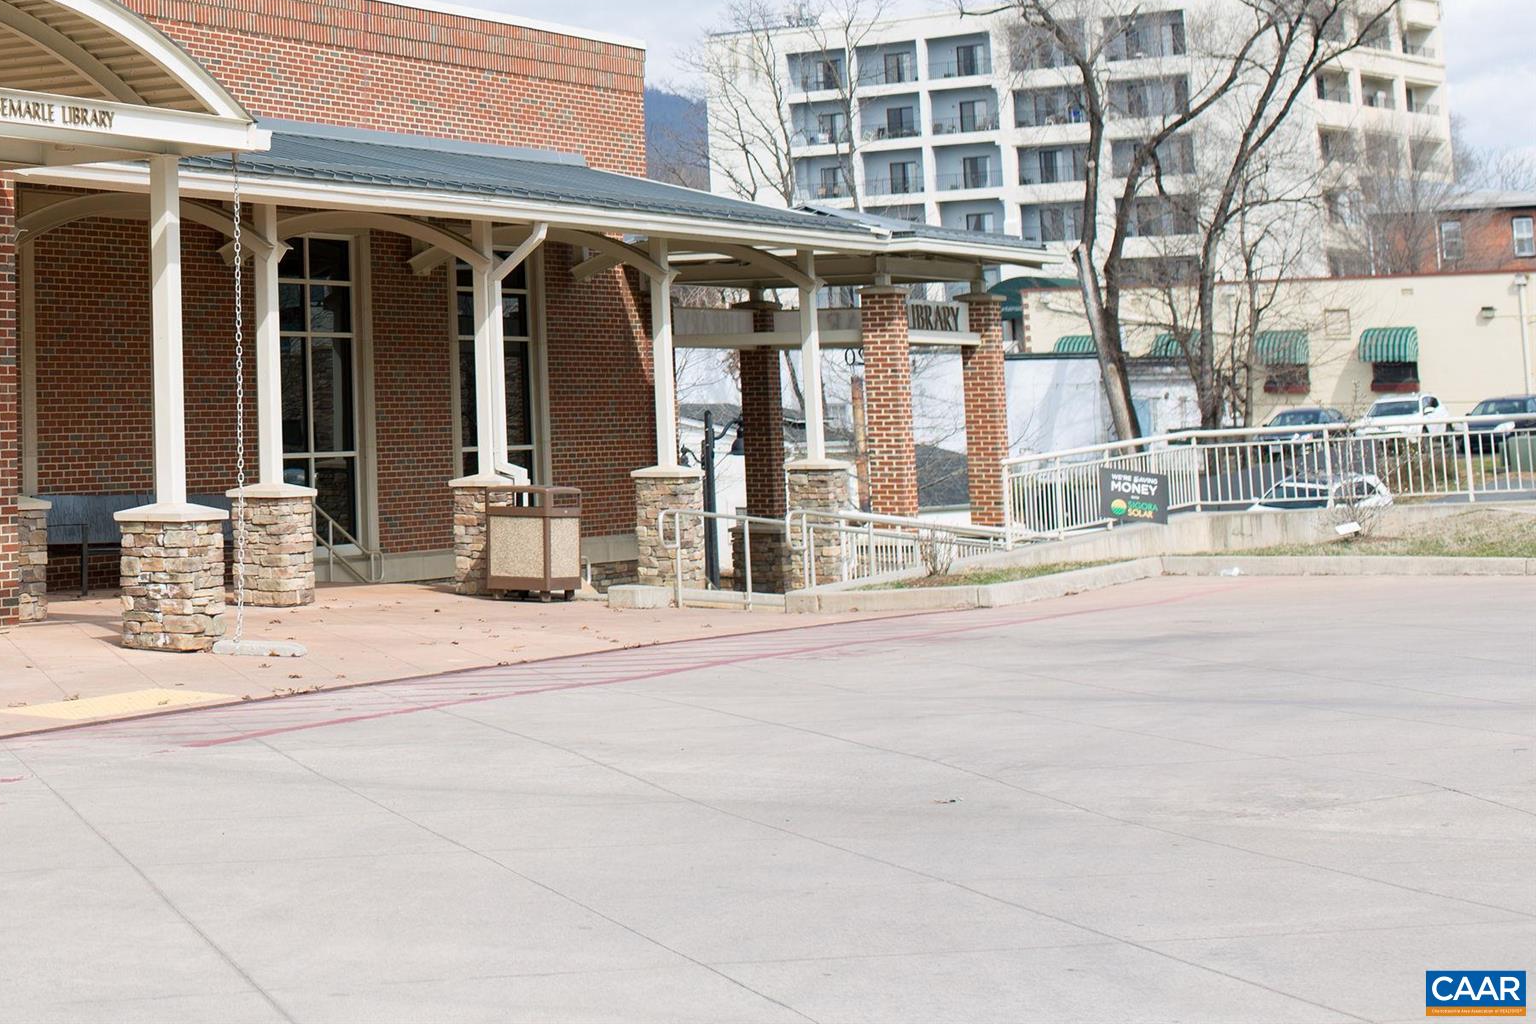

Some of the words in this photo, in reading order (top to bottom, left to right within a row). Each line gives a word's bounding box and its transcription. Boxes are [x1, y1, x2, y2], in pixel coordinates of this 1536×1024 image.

[61, 106, 115, 128] LIBRARY
[907, 304, 960, 332] IBRARY
[1110, 480, 1158, 496] MONEY
[1133, 476, 1158, 485] SAVING
[1127, 508, 1154, 519] SOLAR
